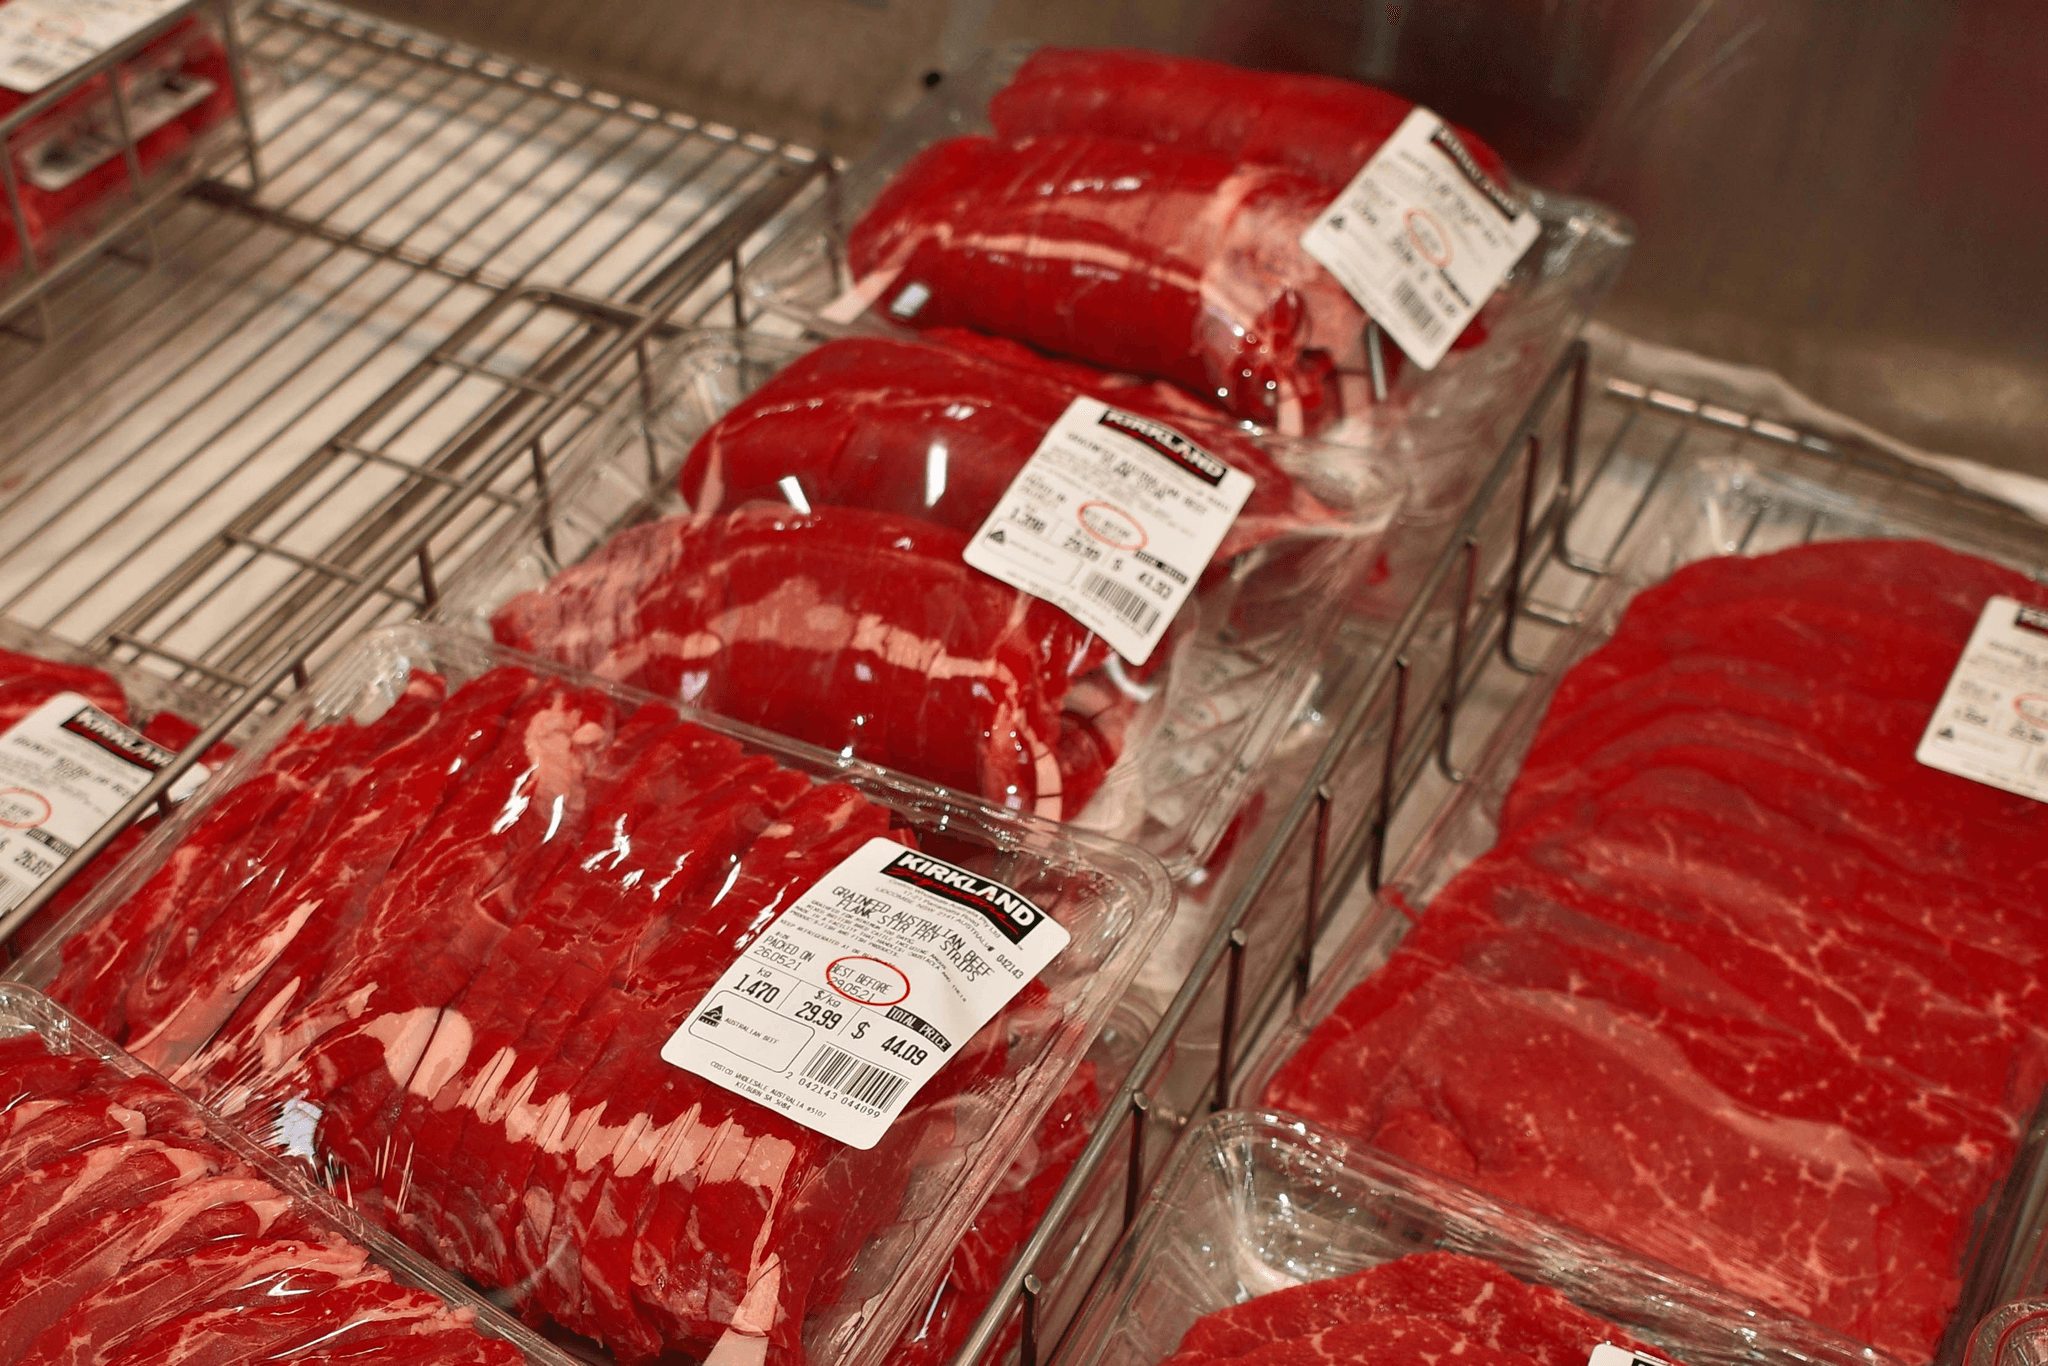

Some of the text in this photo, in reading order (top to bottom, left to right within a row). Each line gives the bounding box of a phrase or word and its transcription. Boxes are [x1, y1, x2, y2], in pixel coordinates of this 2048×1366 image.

[1105, 411, 1223, 477] KIRKLAND
[75, 708, 175, 768] KIRKLAN
[897, 853, 1036, 927] KIRKLAND
[832, 886, 996, 977] GRAINFED AUSTRALIAN BEEF
[836, 898, 980, 982] FLANK STIR FRY STRIPS
[753, 945, 802, 972] 26.05.21
[763, 935, 816, 963] PACKED ON
[756, 966, 773, 979] kg
[829, 962, 894, 996] BEST BEFORE
[996, 954, 1024, 980] 042143
[733, 973, 781, 1004] 1.470
[814, 989, 842, 1008] $/kg
[724, 1017, 762, 1038] AUSTRALIAN
[794, 1001, 843, 1030] 29.99
[887, 1006, 949, 1050] TOTAL PRICE
[851, 1021, 929, 1066] $ 44.09
[710, 1060, 734, 1075] COSTCO
[735, 1072, 769, 1091] WHOLESALE
[770, 1088, 805, 1109] AUSTRALIA
[734, 1081, 763, 1098] KILBURN
[763, 1093, 773, 1102] SA
[785, 1071, 881, 1119] 2 042143 044099
